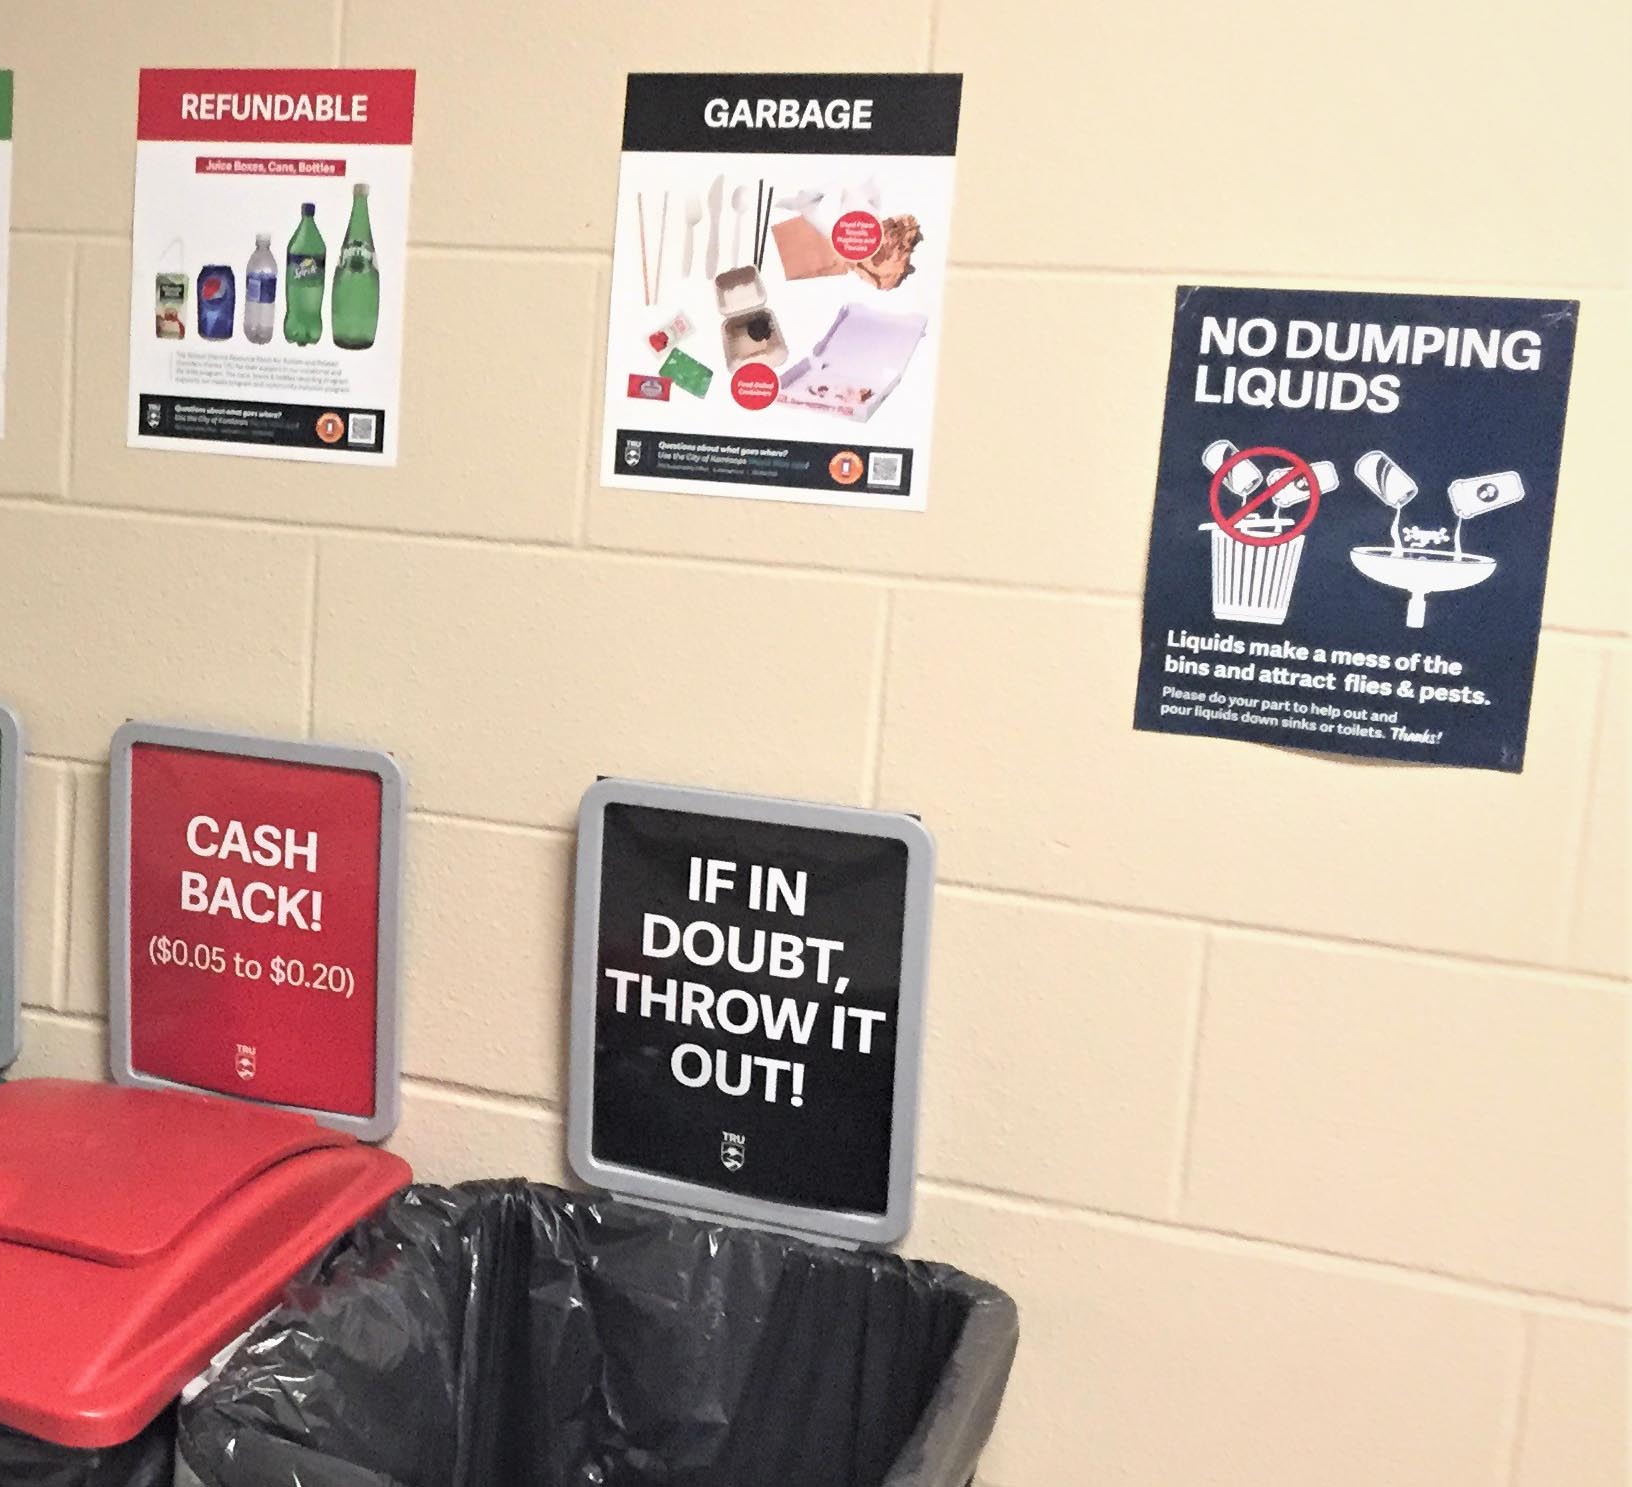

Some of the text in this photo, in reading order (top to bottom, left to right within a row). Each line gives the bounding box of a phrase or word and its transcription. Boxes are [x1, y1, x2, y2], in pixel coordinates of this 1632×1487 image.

[181, 93, 368, 121] REFUNDABLE
[704, 98, 873, 129] GARBAGE
[206, 160, 336, 174] Juice Boxes, Cans, Bottles
[1199, 316, 1542, 371] NO DUMPING
[1194, 364, 1400, 414] LIQUIDS
[658, 441, 696, 451] Questions
[696, 444, 720, 453] about
[720, 445, 740, 454] what
[1168, 630, 1463, 677] Liquids make a mess of the
[1162, 686, 1398, 724] Please do your part to help out and
[1165, 655, 1492, 706] bins and attract flies & pests.
[1160, 704, 1443, 745] pour liquids down sinks or toilets. Thanks!
[186, 815, 318, 873] CASH
[181, 870, 322, 932] BACK!
[688, 856, 807, 917] IF IN
[148, 935, 355, 999] ($0.05 to $0.20)
[642, 912, 850, 995] DOUBT,
[604, 968, 887, 1054] THROW IT
[236, 1043, 256, 1055] TRU
[670, 1042, 805, 1108] OUT!
[722, 1130, 746, 1145] TRU
